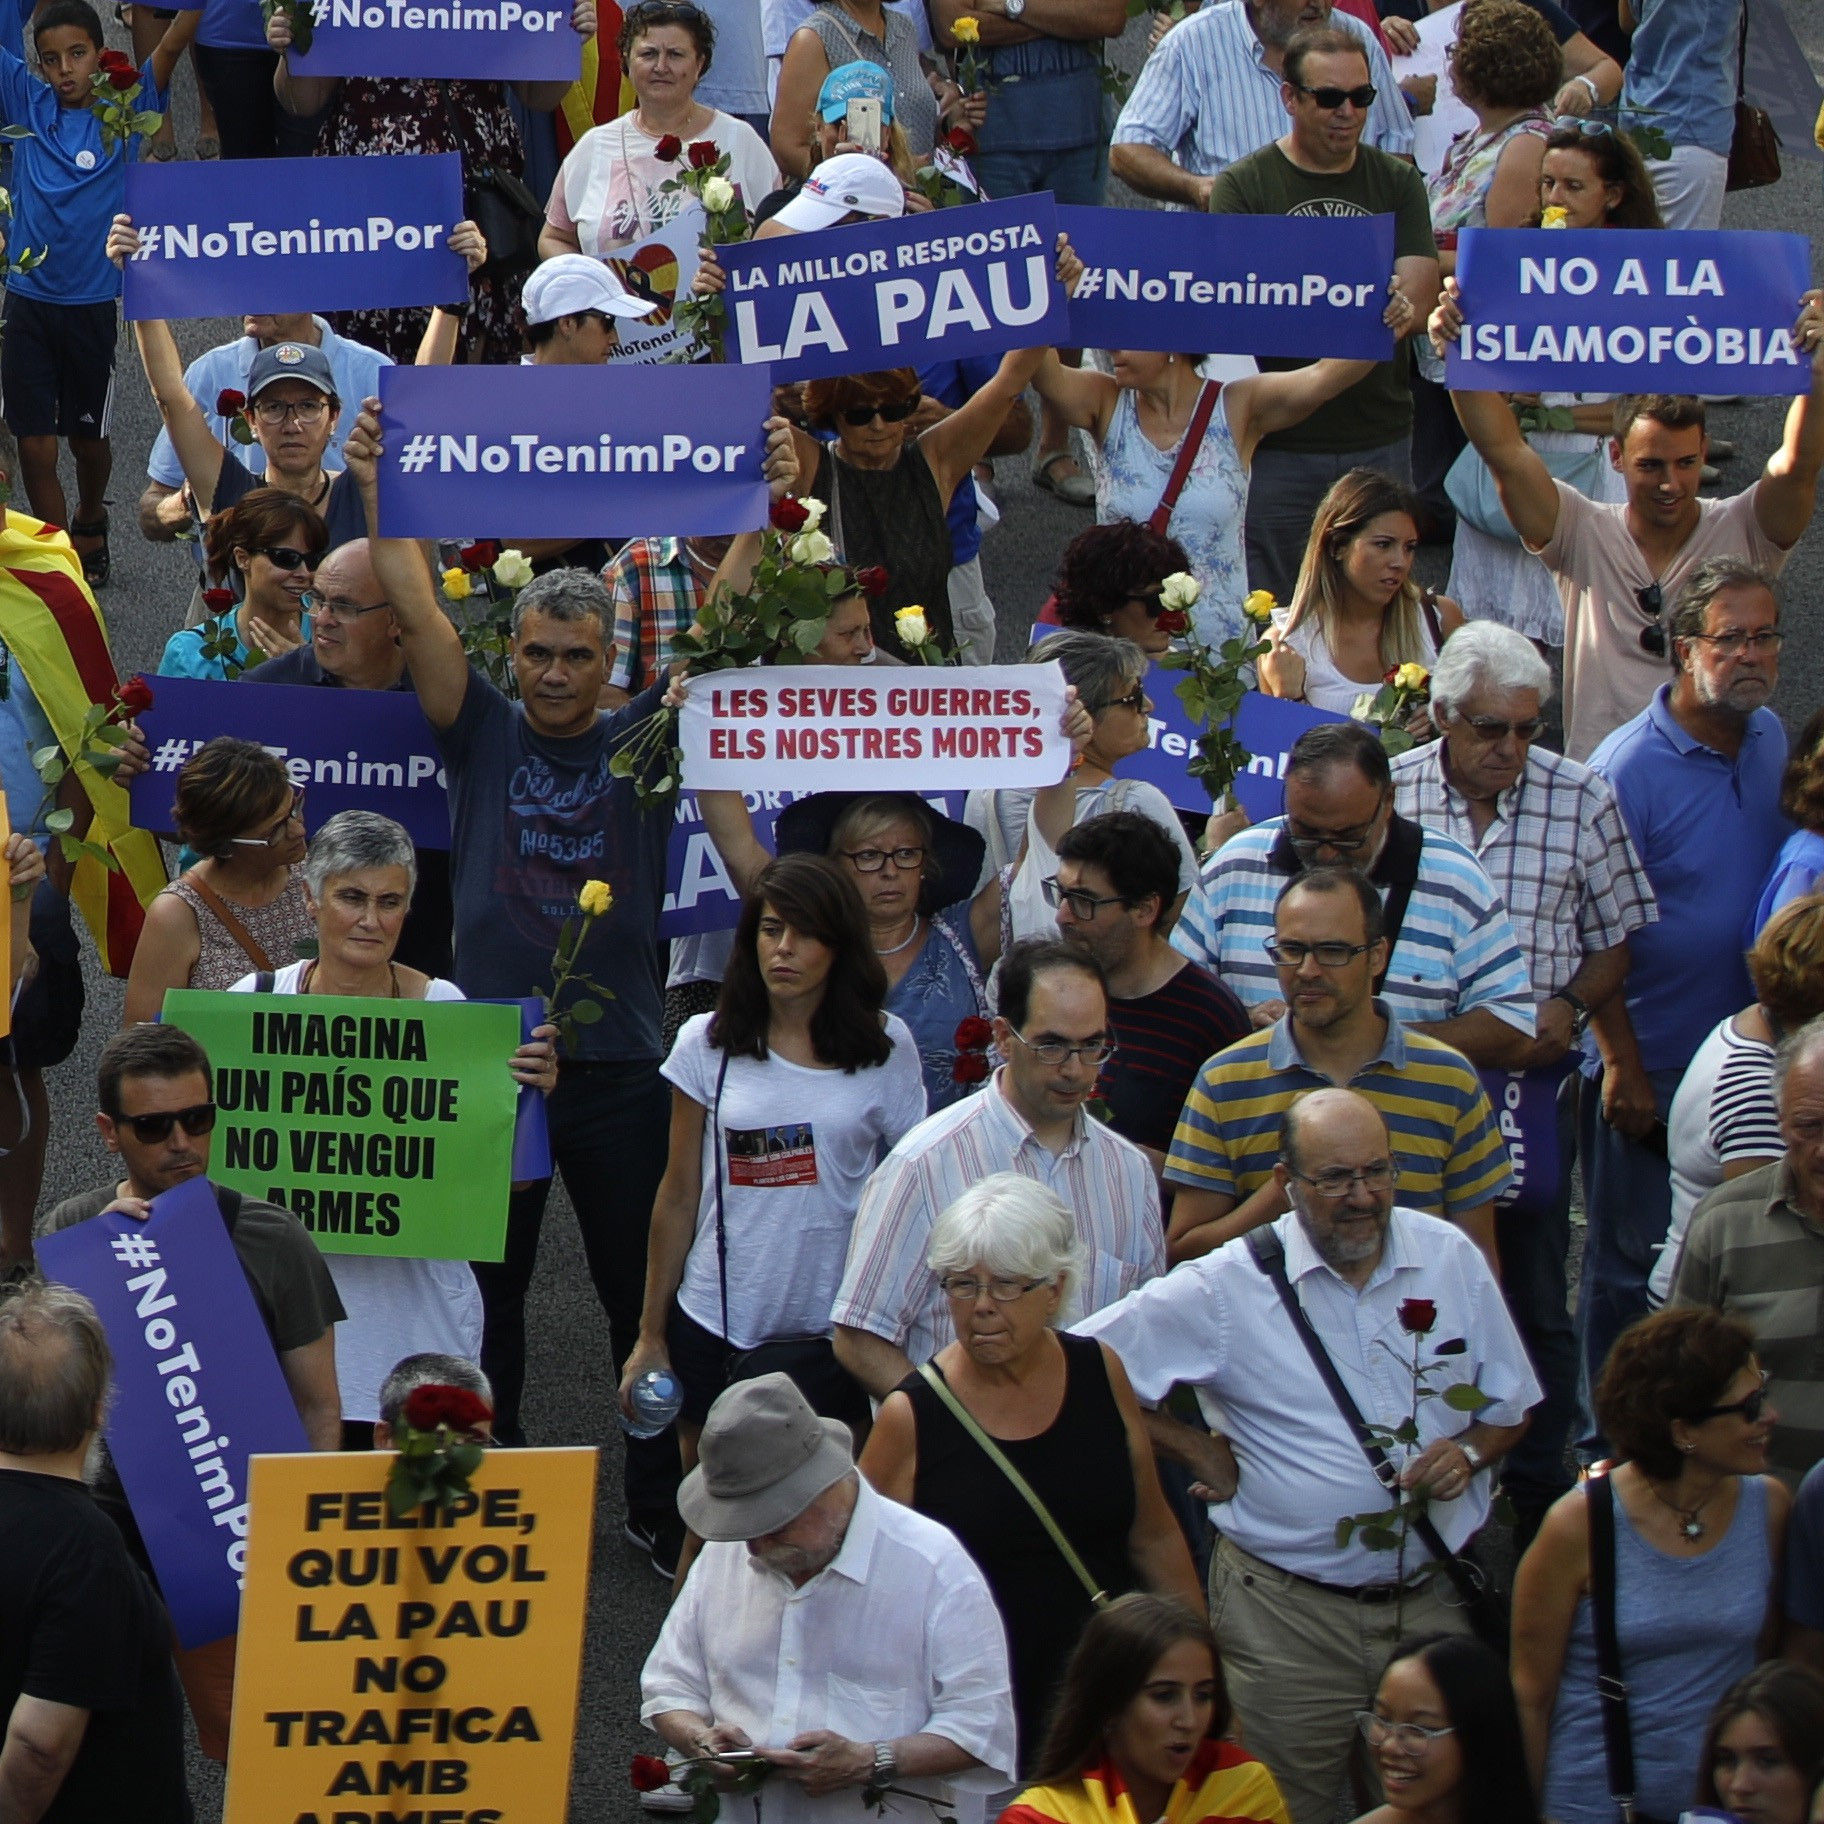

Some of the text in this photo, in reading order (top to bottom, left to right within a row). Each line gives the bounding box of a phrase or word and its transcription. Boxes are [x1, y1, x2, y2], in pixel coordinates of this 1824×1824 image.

[1072, 267, 1375, 307] #NoTenimPor
[1519, 256, 1725, 296] NO A LA
[1460, 316, 1798, 364] ISLAMOFÒBIA
[399, 433, 746, 473] #NoTenimPor
[252, 1012, 428, 1062] IMAGINA
[216, 1065, 459, 1124] UN PAÍS QUE
[225, 1126, 435, 1180] NO VENGUI
[287, 1544, 547, 1588] QUI VOL
[296, 1599, 530, 1642] LA PAU
[353, 1655, 448, 1696] NO
[265, 1706, 542, 1748] TRAFICA
[326, 1759, 469, 1796] AMB
